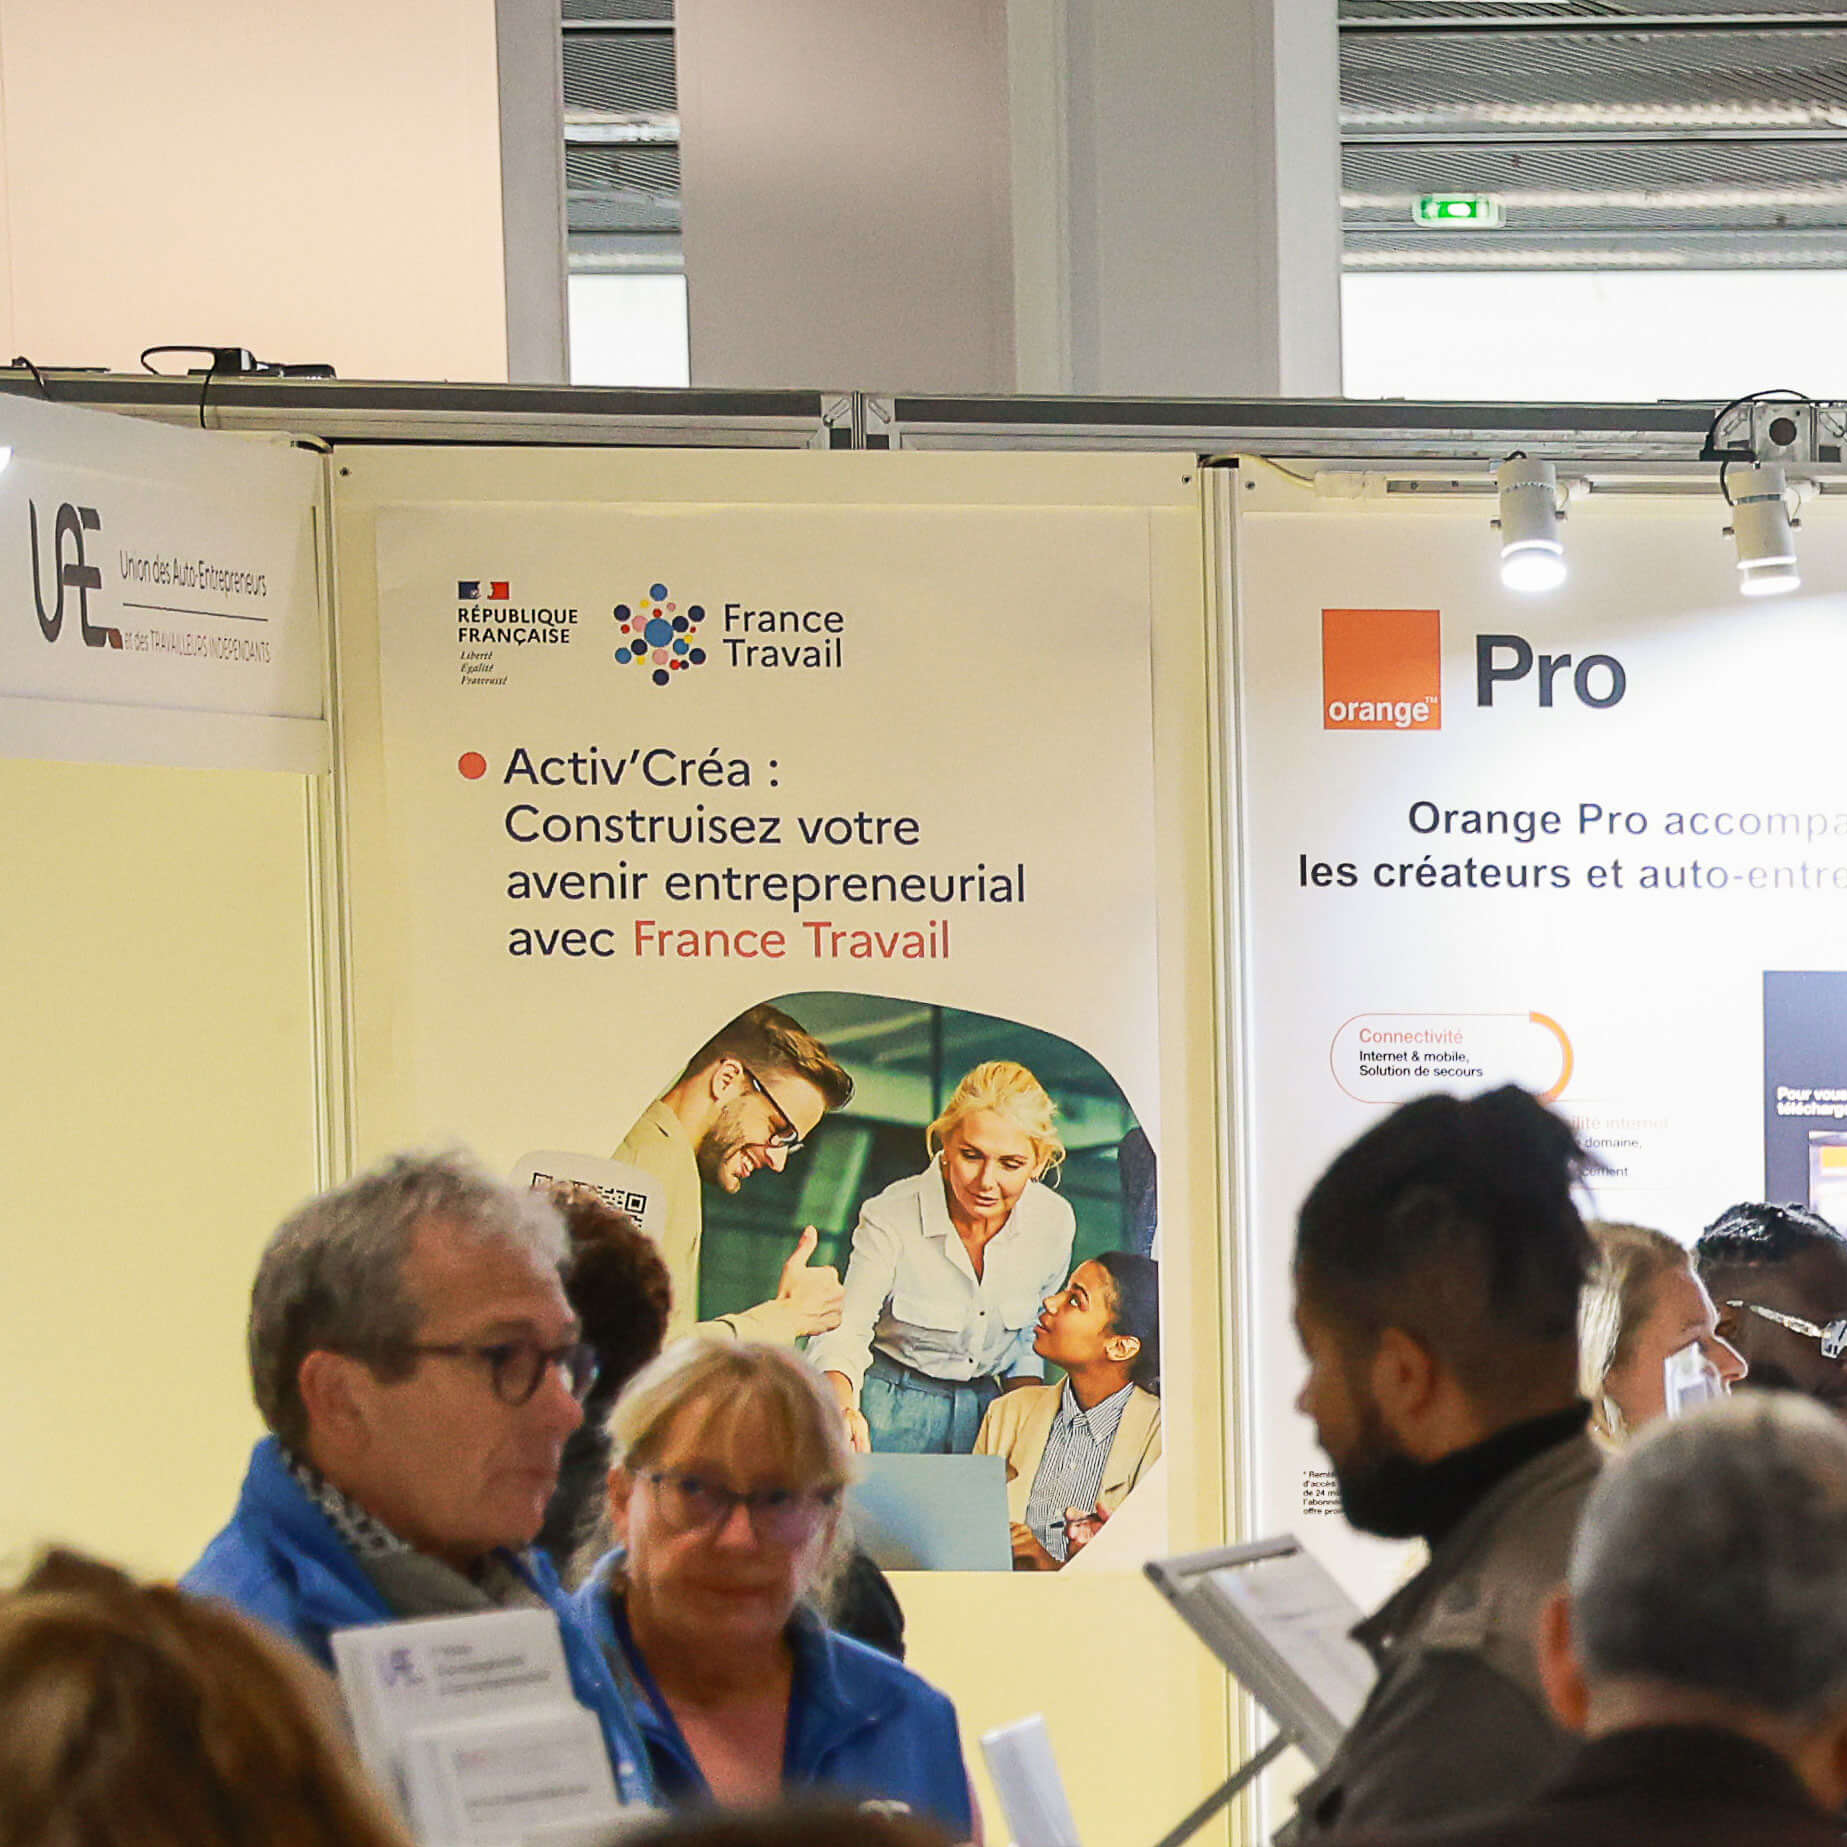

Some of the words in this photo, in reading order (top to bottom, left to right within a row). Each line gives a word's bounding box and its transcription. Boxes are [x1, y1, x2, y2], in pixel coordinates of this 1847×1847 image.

[28, 498, 123, 650] UAE
[119, 549, 150, 583] Union
[152, 554, 171, 585] des
[172, 557, 267, 599] Auto-Entrepreneurs
[458, 603, 579, 627] RÉPUBLIQUE
[723, 603, 844, 633] France
[458, 627, 571, 646] FRANÇAISE
[723, 637, 842, 668] Travail
[1476, 634, 1627, 709] Pro
[504, 803, 781, 844] Construisez
[797, 811, 920, 845] votre
[1408, 801, 1561, 843] Orange
[1578, 803, 1648, 834] Pro
[507, 860, 648, 900] avenir
[665, 863, 1025, 913] entrepreneurial
[1300, 853, 1358, 888] les
[1373, 854, 1571, 889] créateurs
[1586, 858, 1624, 889] et
[508, 926, 615, 957] avec
[634, 920, 786, 959] France
[802, 919, 949, 959] Travail
[1359, 1027, 1464, 1045] Connectivité
[1359, 1050, 1408, 1062] Internet
[1411, 1051, 1421, 1062] &
[1424, 1051, 1470, 1064] mobile,
[1359, 1064, 1411, 1077] Solution
[1414, 1065, 1430, 1077] de
[1433, 1067, 1483, 1078] secours
[1776, 1086, 1814, 1102] Pour
